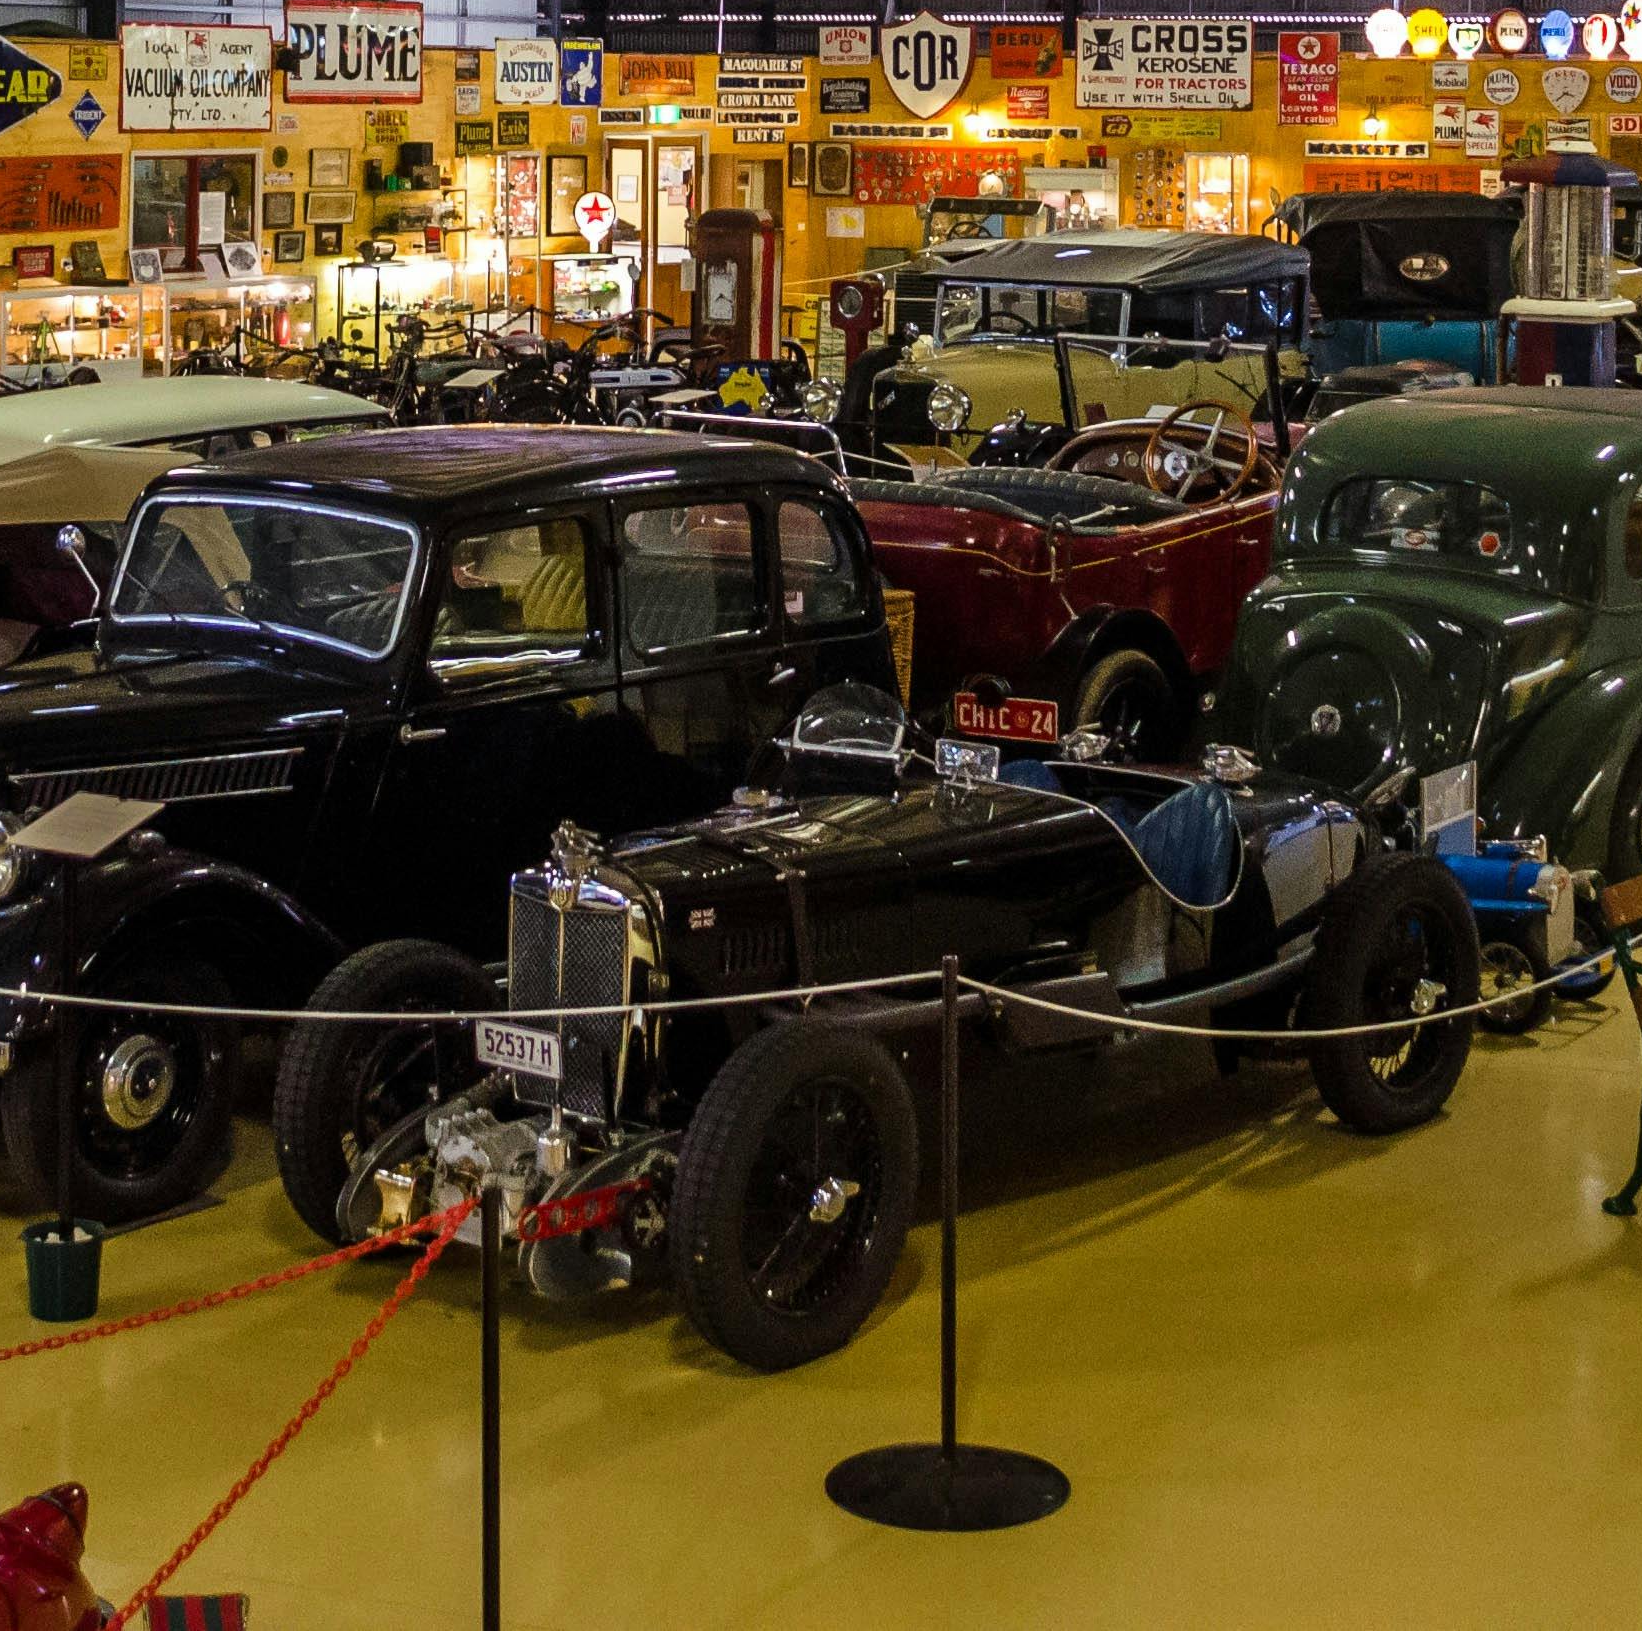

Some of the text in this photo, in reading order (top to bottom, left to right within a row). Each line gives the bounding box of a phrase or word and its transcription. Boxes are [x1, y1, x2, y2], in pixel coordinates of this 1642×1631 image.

[825, 27, 867, 45] UNION
[1414, 25, 1444, 37] SHELL
[1500, 27, 1524, 37] PLUME
[996, 32, 1044, 47] BERU
[1131, 24, 1248, 53] CROSS
[219, 42, 253, 55] AGENT
[289, 23, 419, 81] PLUME
[1083, 38, 1123, 61] CROSS
[724, 58, 788, 72] MACQUARIE
[892, 31, 959, 91] COR
[1137, 57, 1237, 74] KEROSENE
[500, 61, 553, 83] AUSTIN
[624, 59, 661, 80] JOHN
[1282, 63, 1337, 75] TEXACO
[125, 68, 270, 97] VACUUM OIL COMPANY
[1135, 78, 1247, 90] FOR TRACTORS
[1434, 78, 1467, 88] Mobiloil
[1487, 72, 1515, 85] PLUME
[1609, 75, 1637, 88] VOCO
[1009, 86, 1048, 100] National
[1287, 83, 1330, 92] MOTOR
[1611, 89, 1636, 97] Petrol
[720, 94, 795, 107] CROWN LANE
[1083, 92, 1239, 104] USE IT WITH SHELL OIL
[1299, 93, 1318, 102] OIL
[171, 108, 226, 121] PTY. LTD.
[1281, 105, 1319, 113] Leaves
[367, 111, 407, 127] SHELL
[717, 112, 784, 124] LIVERPOOL
[1281, 114, 1336, 124] hard carbon
[1548, 125, 1589, 135] CHAMPION
[1612, 118, 1637, 132] 3D
[460, 124, 490, 141] Plume
[737, 129, 769, 142] KENT
[1434, 126, 1463, 140] PLUME
[375, 135, 403, 145] SPIRIT
[1467, 141, 1497, 150] SPECIAL
[1307, 142, 1399, 155] MARKET
[1031, 712, 1053, 735] 24
[484, 1028, 552, 1066] 52537 H
